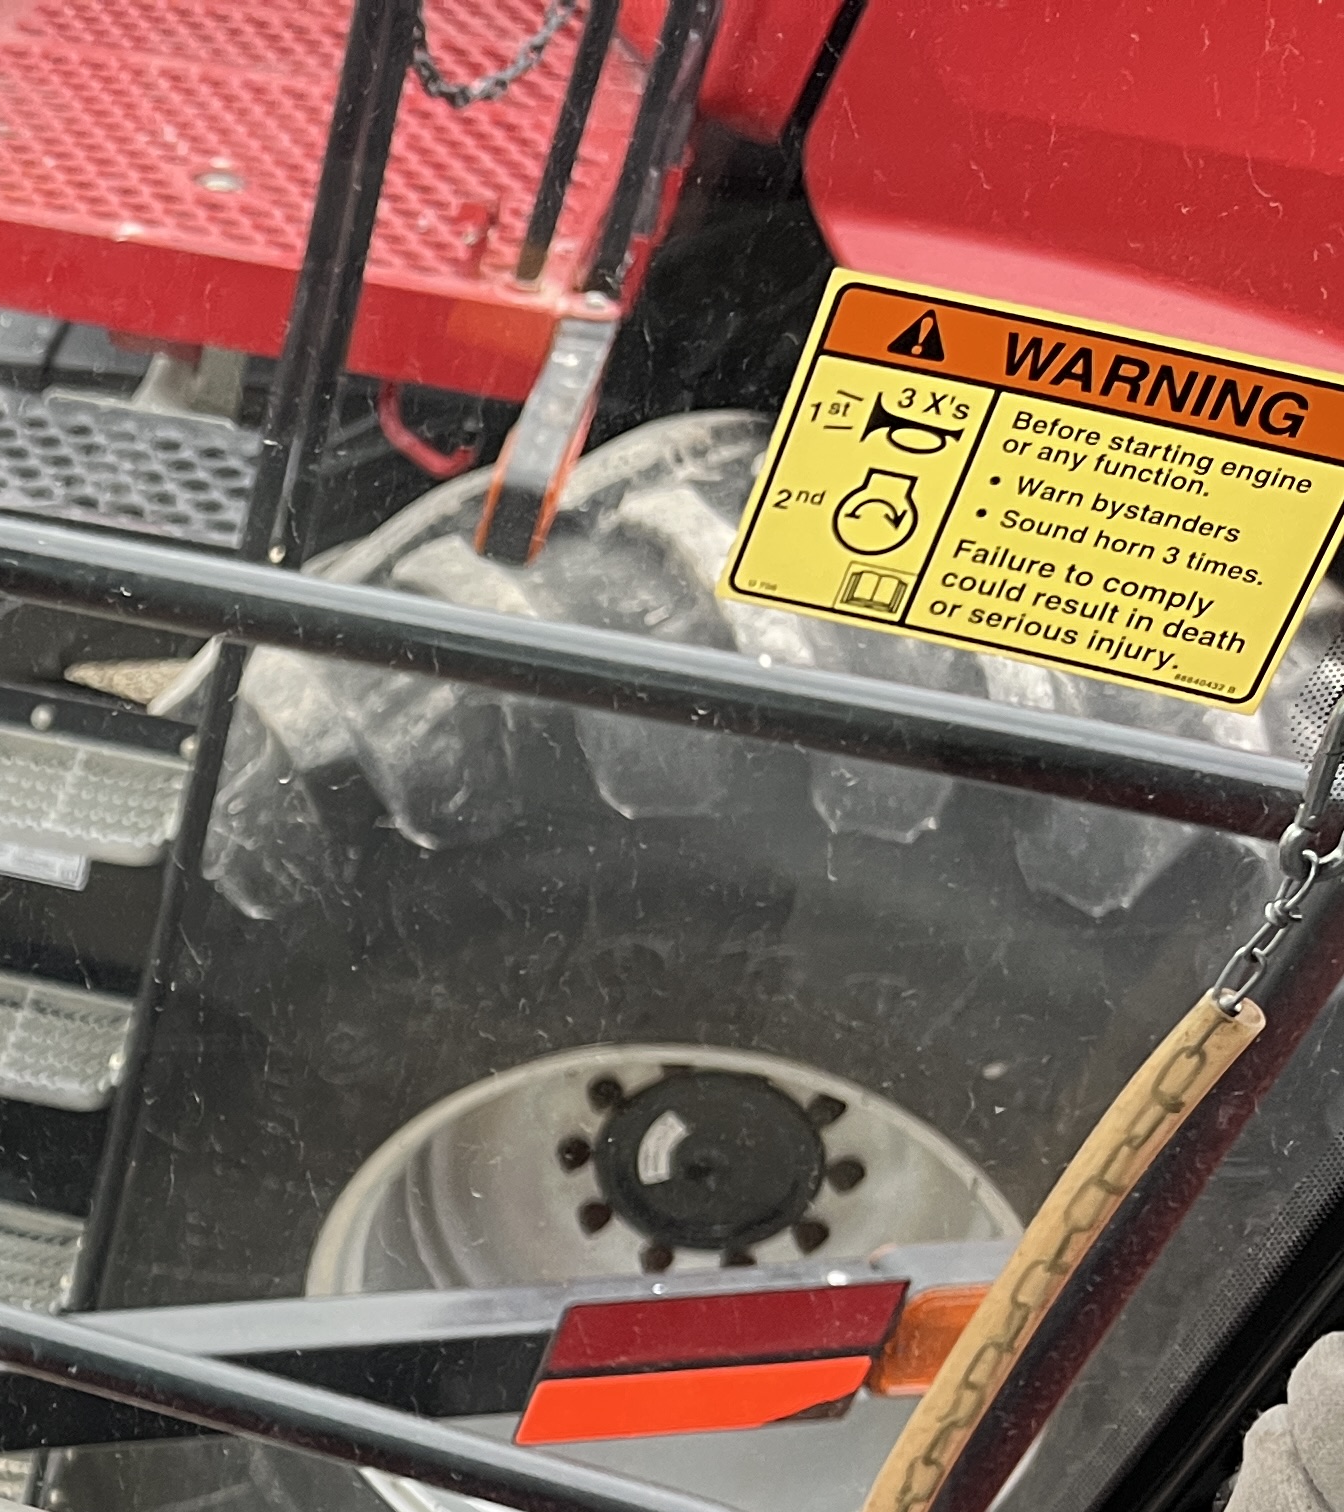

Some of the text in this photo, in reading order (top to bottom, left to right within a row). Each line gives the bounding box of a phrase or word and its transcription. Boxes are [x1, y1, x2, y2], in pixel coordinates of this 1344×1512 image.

[811, 401, 850, 422] 1st
[897, 387, 970, 420] 3 X's
[1004, 331, 1309, 438] WARNING
[1002, 438, 1208, 496] or any function.
[1011, 410, 1312, 494] Before starting engine
[772, 488, 826, 509] 2nd
[1017, 475, 1240, 543] Warn bystanders
[952, 538, 1214, 618] Failure to comply
[999, 509, 1262, 585] Sound horn 3 times.
[928, 599, 1180, 672] or serious injury.
[940, 571, 1245, 653] could result in death
